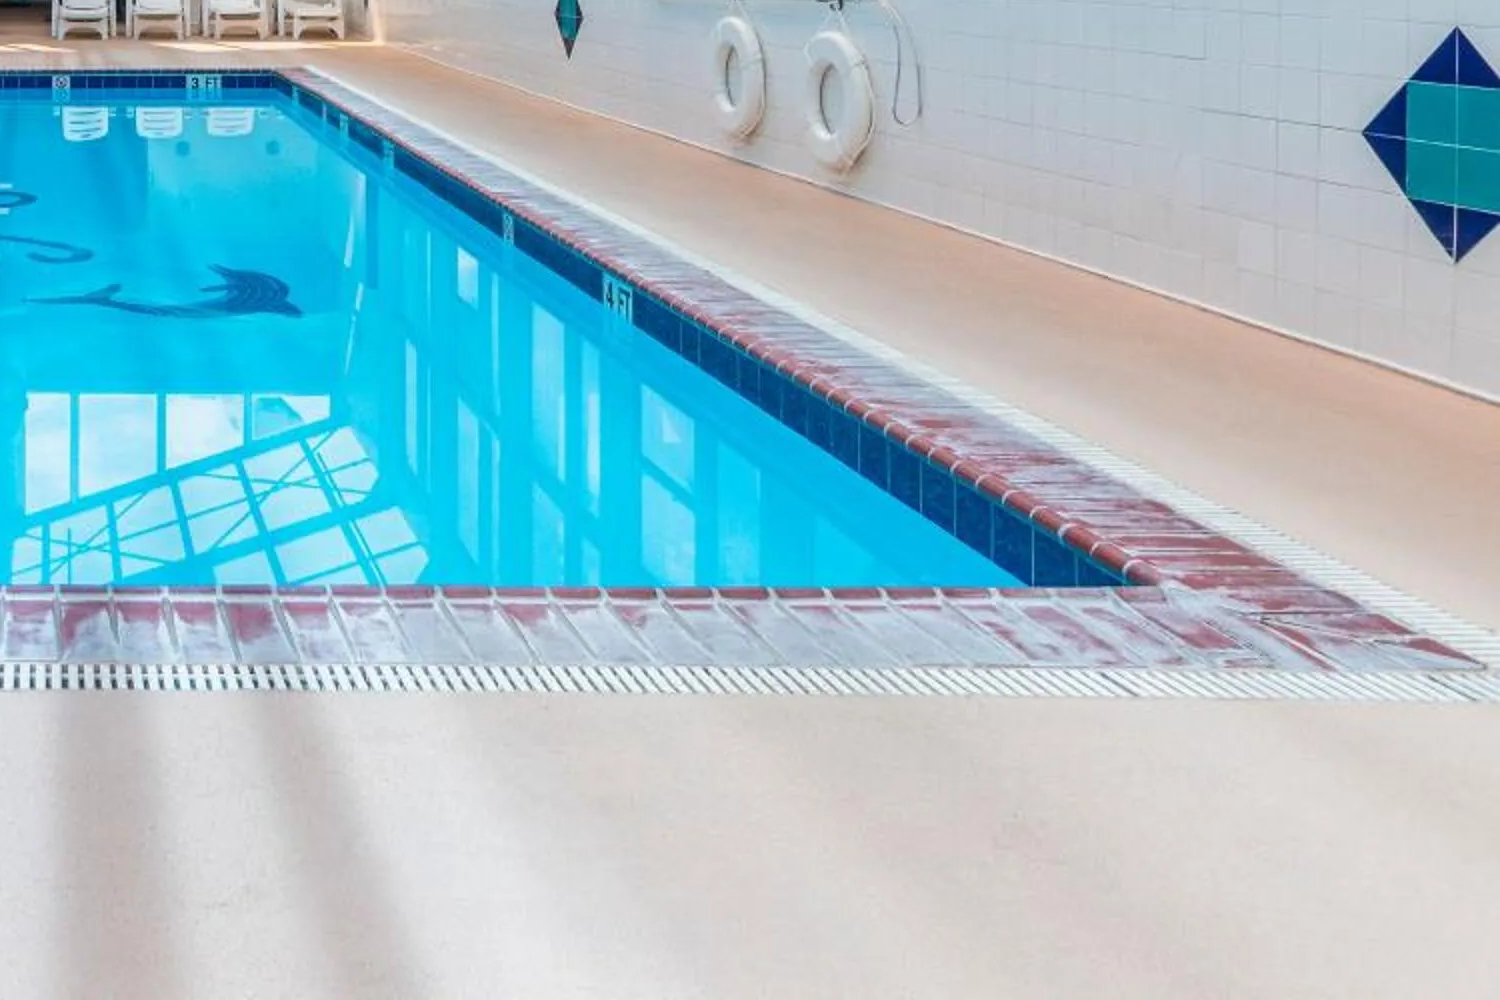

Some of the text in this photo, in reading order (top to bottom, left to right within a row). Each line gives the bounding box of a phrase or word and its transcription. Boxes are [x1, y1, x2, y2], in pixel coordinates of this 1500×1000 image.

[191, 77, 198, 89] 3
[605, 281, 630, 322] 4 FT
